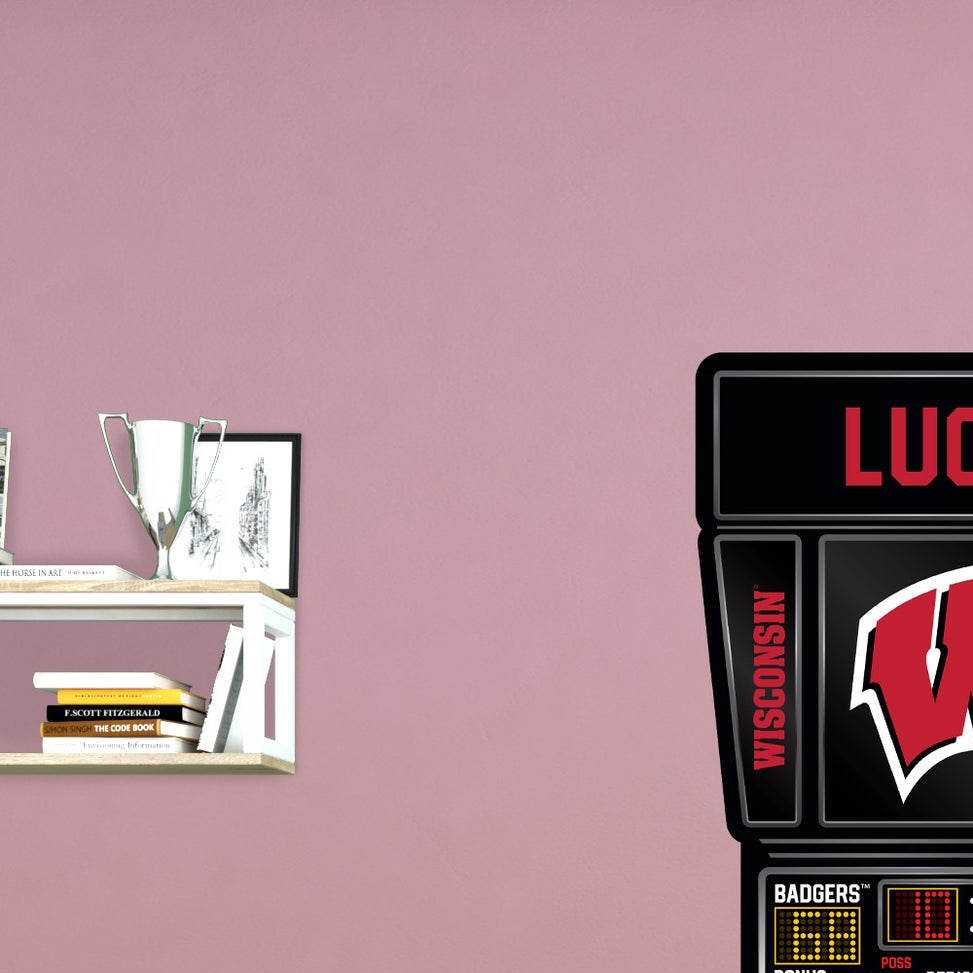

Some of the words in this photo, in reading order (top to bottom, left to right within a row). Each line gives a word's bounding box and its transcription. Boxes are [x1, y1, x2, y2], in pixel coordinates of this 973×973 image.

[12, 569, 36, 577] HORSE
[38, 569, 47, 577] IN
[48, 569, 62, 577] ART
[752, 590, 786, 771] WISCONSIN
[103, 709, 161, 717] FITZGERALD
[44, 725, 68, 733] SIMON
[69, 724, 93, 732] SINGH
[94, 725, 109, 733] THE
[110, 724, 131, 732] CODE
[132, 723, 155, 731] BOOK
[792, 911, 856, 960] 68
[881, 957, 912, 969] POSS
